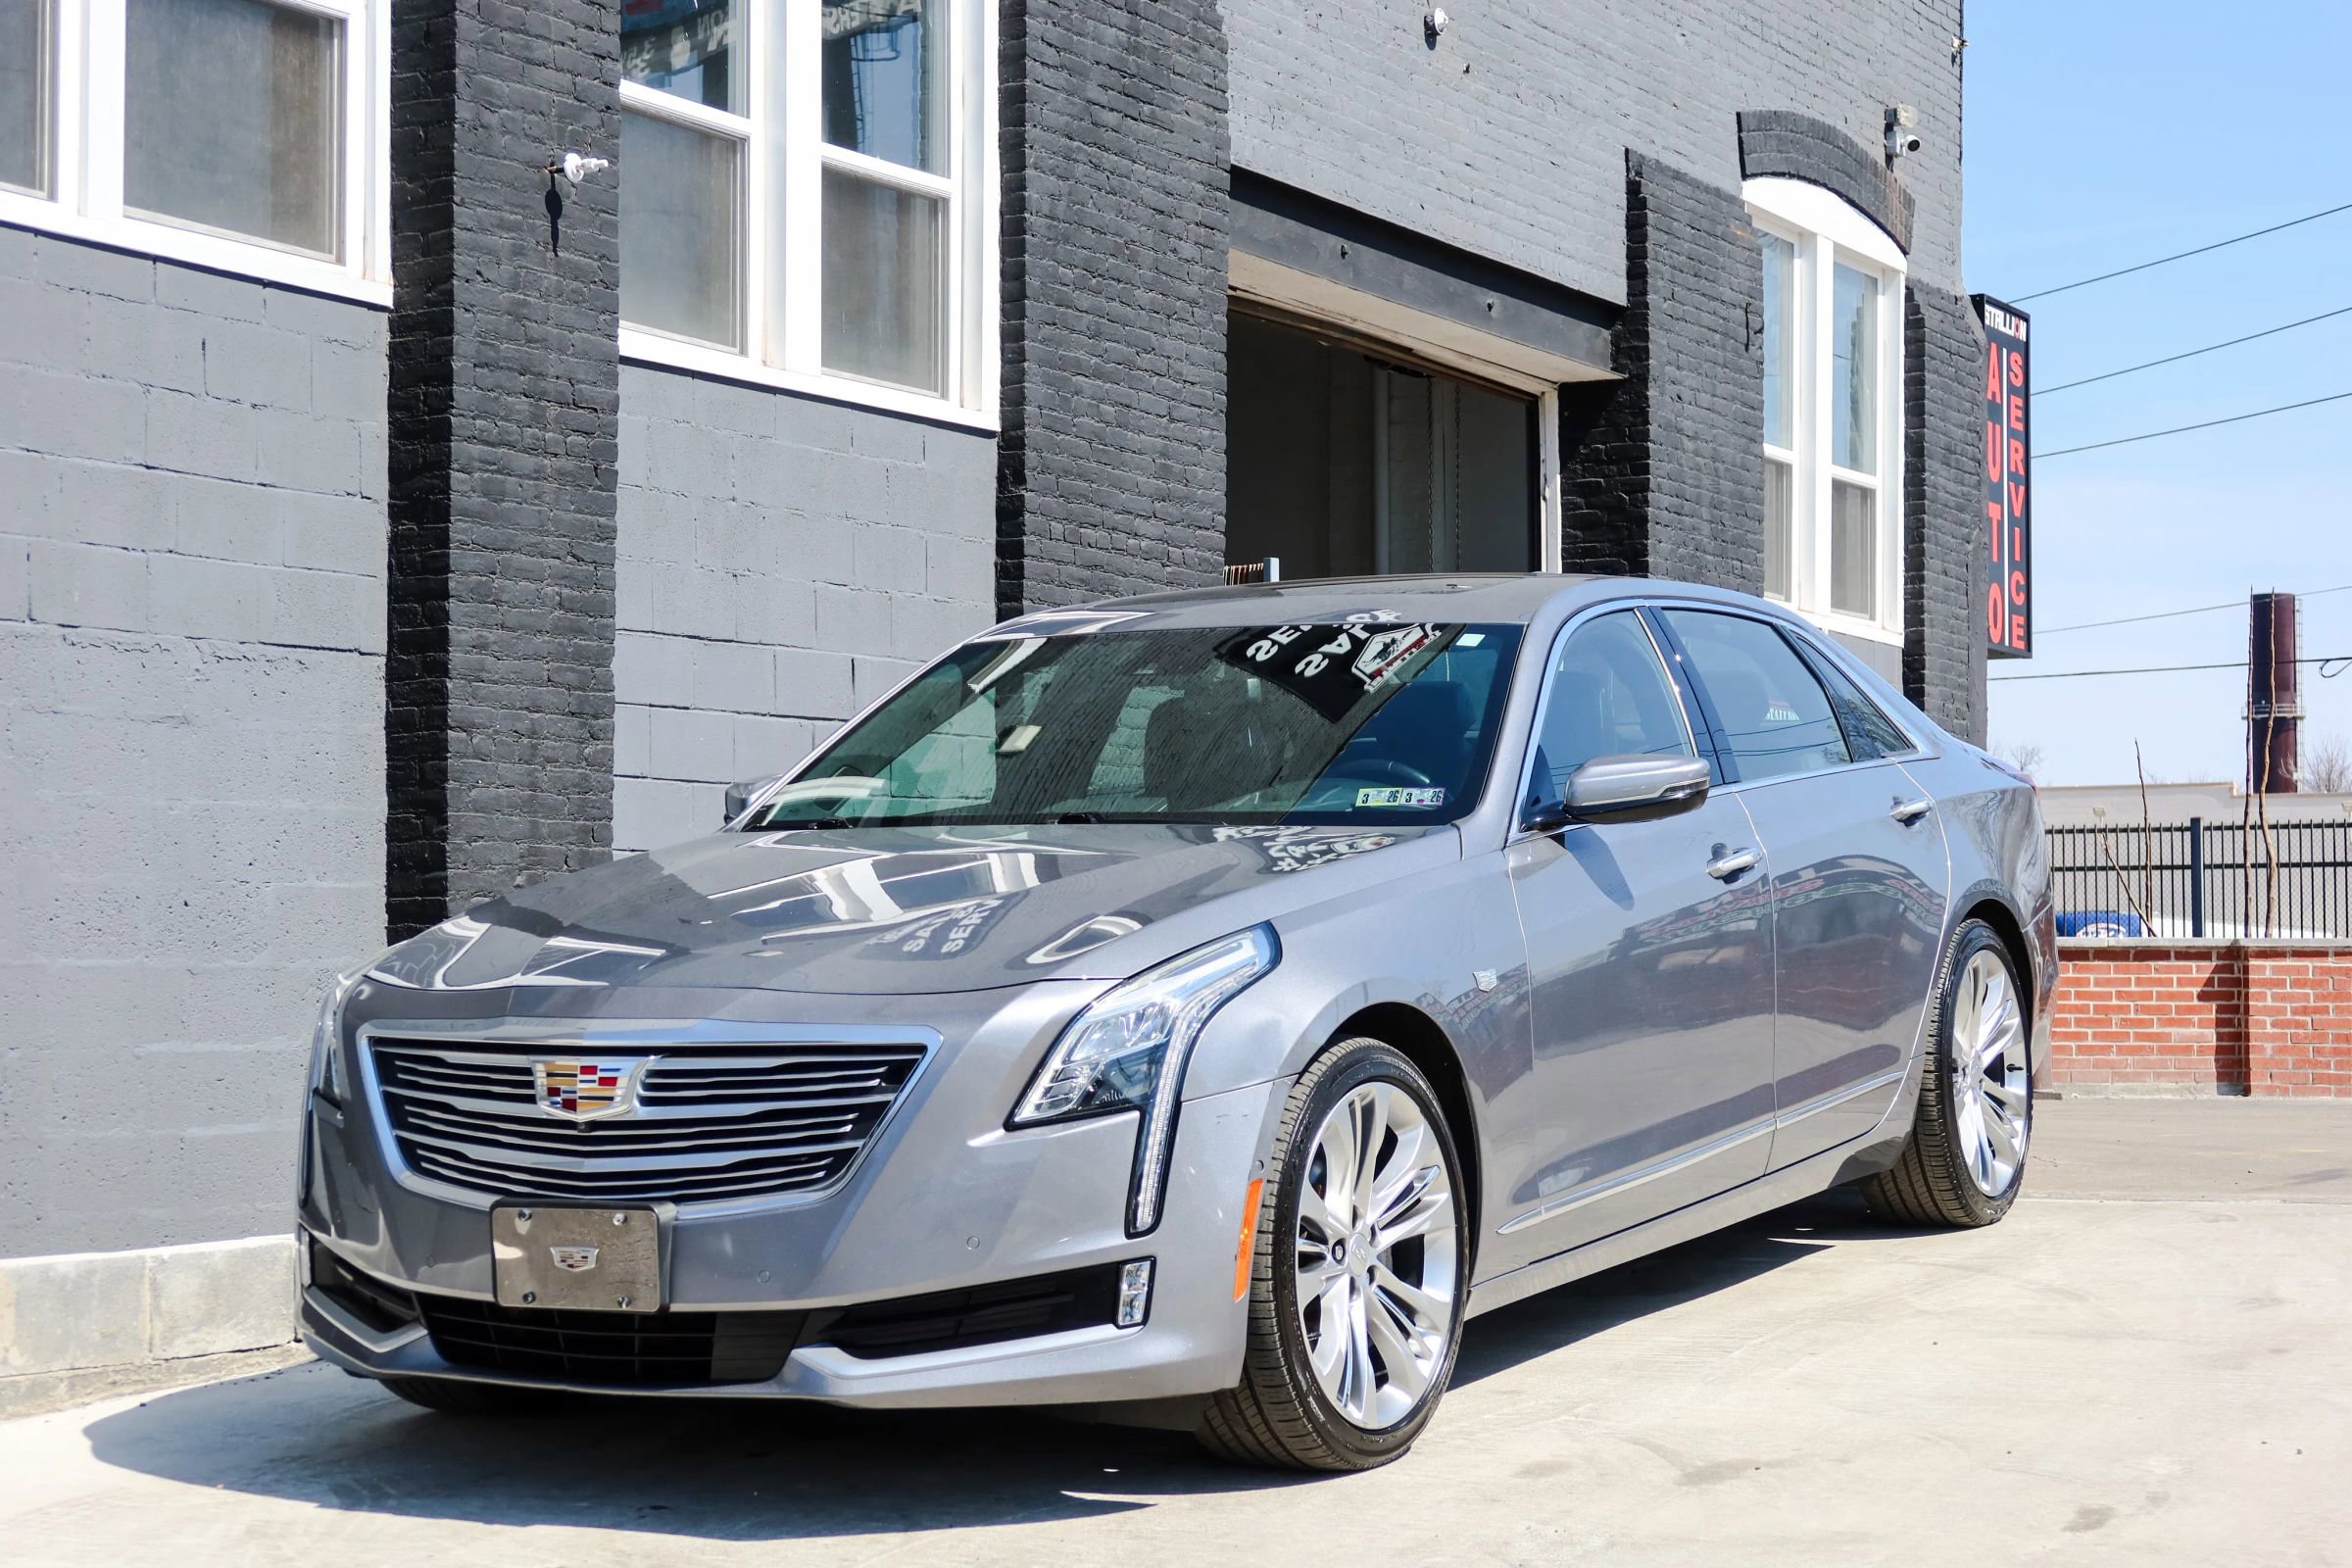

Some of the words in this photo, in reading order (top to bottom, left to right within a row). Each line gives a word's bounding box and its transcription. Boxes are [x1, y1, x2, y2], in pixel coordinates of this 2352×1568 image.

[1984, 303, 2027, 342] STALLION
[1986, 341, 2003, 644] AUTO
[2009, 352, 2026, 650] SERVICE
[1362, 793, 1370, 804] 3
[1387, 790, 1399, 803] 26
[1405, 792, 1412, 803] 3
[1431, 790, 1443, 803] 26
